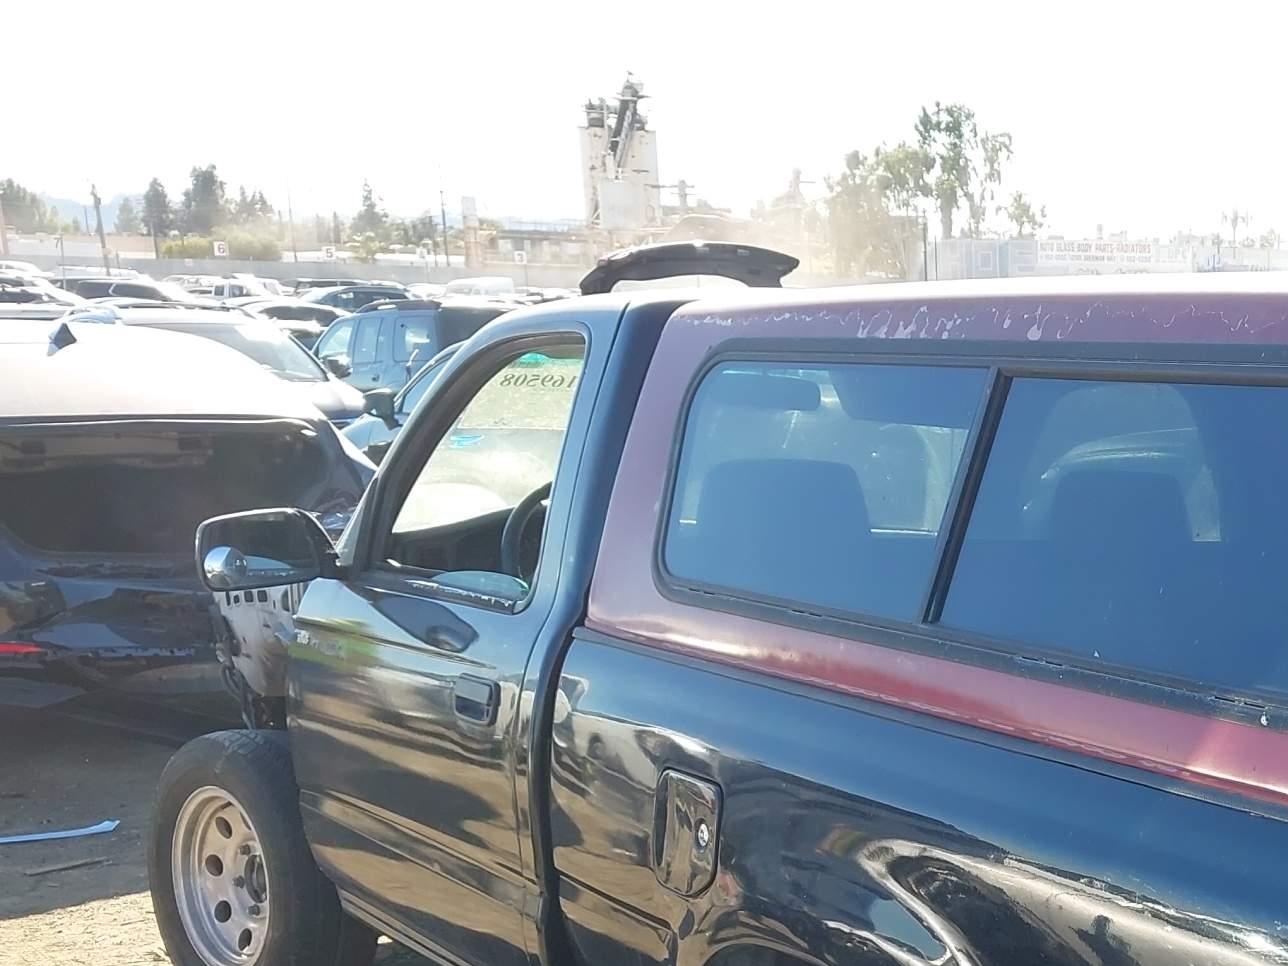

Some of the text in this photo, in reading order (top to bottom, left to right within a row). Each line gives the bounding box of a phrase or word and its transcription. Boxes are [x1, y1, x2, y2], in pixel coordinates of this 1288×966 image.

[217, 243, 225, 254] 6
[325, 248, 334, 258] 5
[1056, 243, 1075, 253] GLASS
